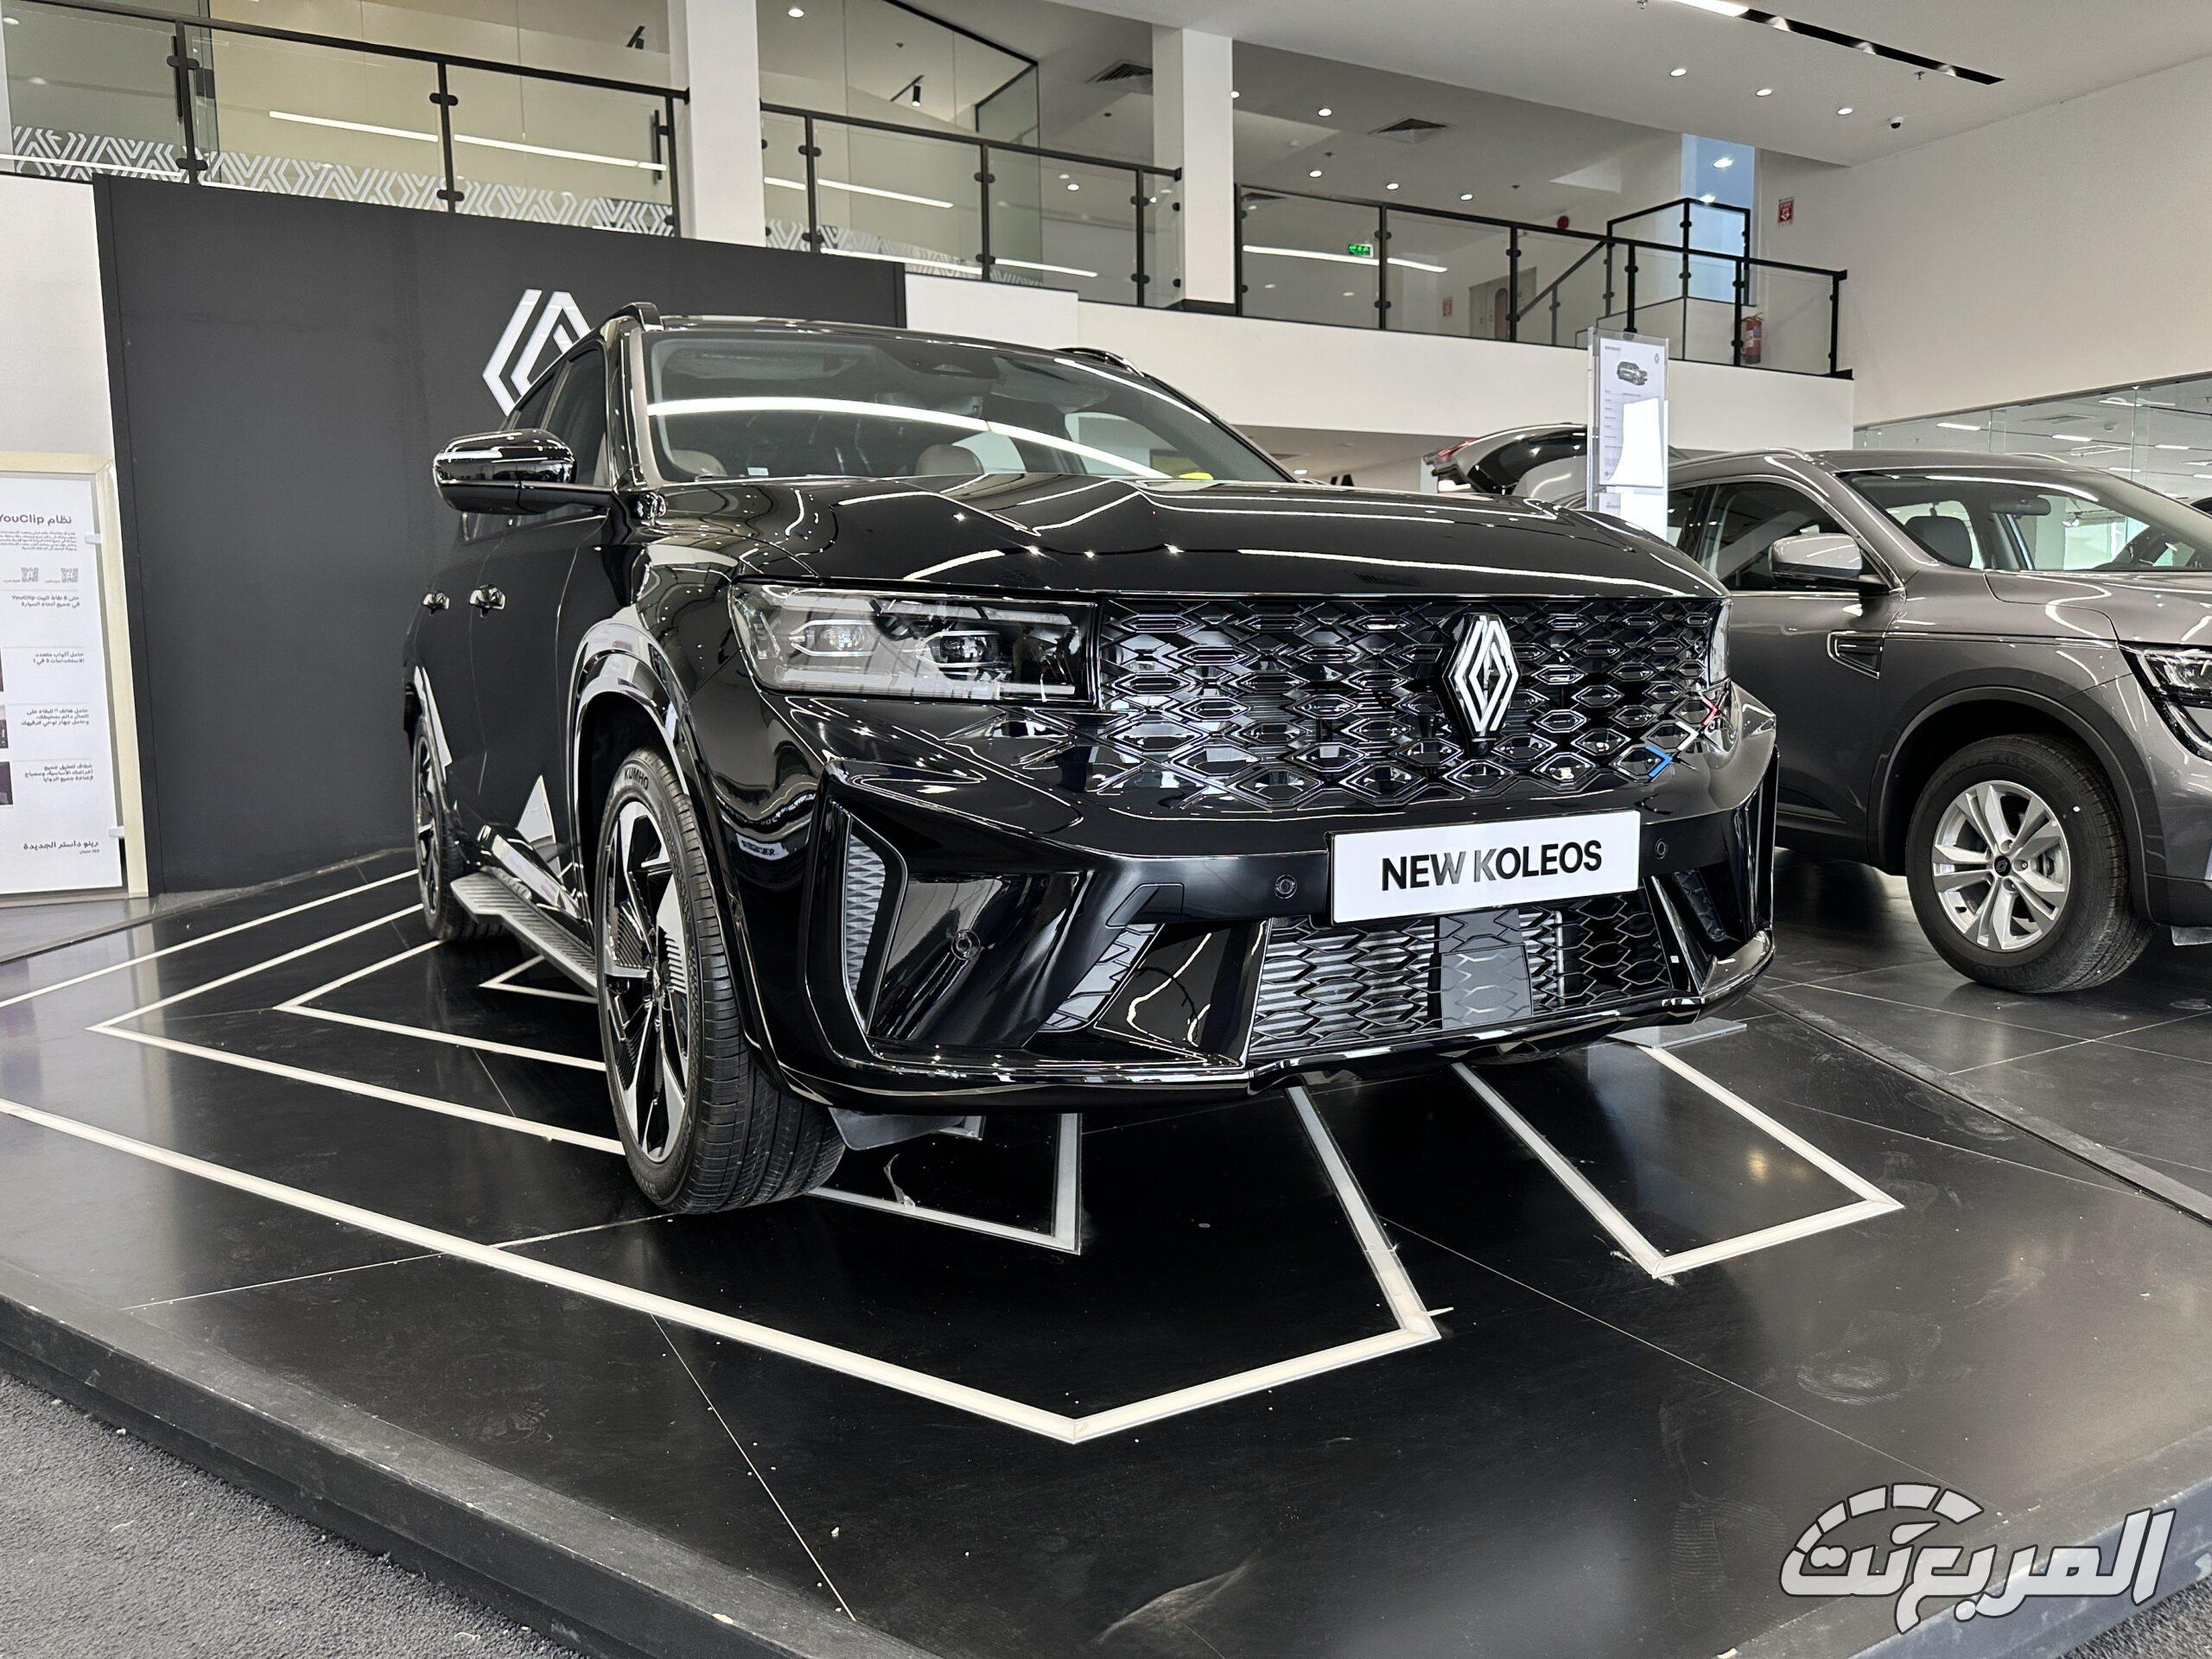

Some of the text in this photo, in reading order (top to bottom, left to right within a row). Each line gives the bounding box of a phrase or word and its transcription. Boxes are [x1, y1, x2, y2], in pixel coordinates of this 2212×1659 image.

[47, 514, 72, 526] نظام
[624, 766, 649, 791] KUMHO
[23, 841, 56, 851] الجديدة
[58, 840, 81, 849] داستر
[1382, 840, 1602, 891] NEW KOLEOS
